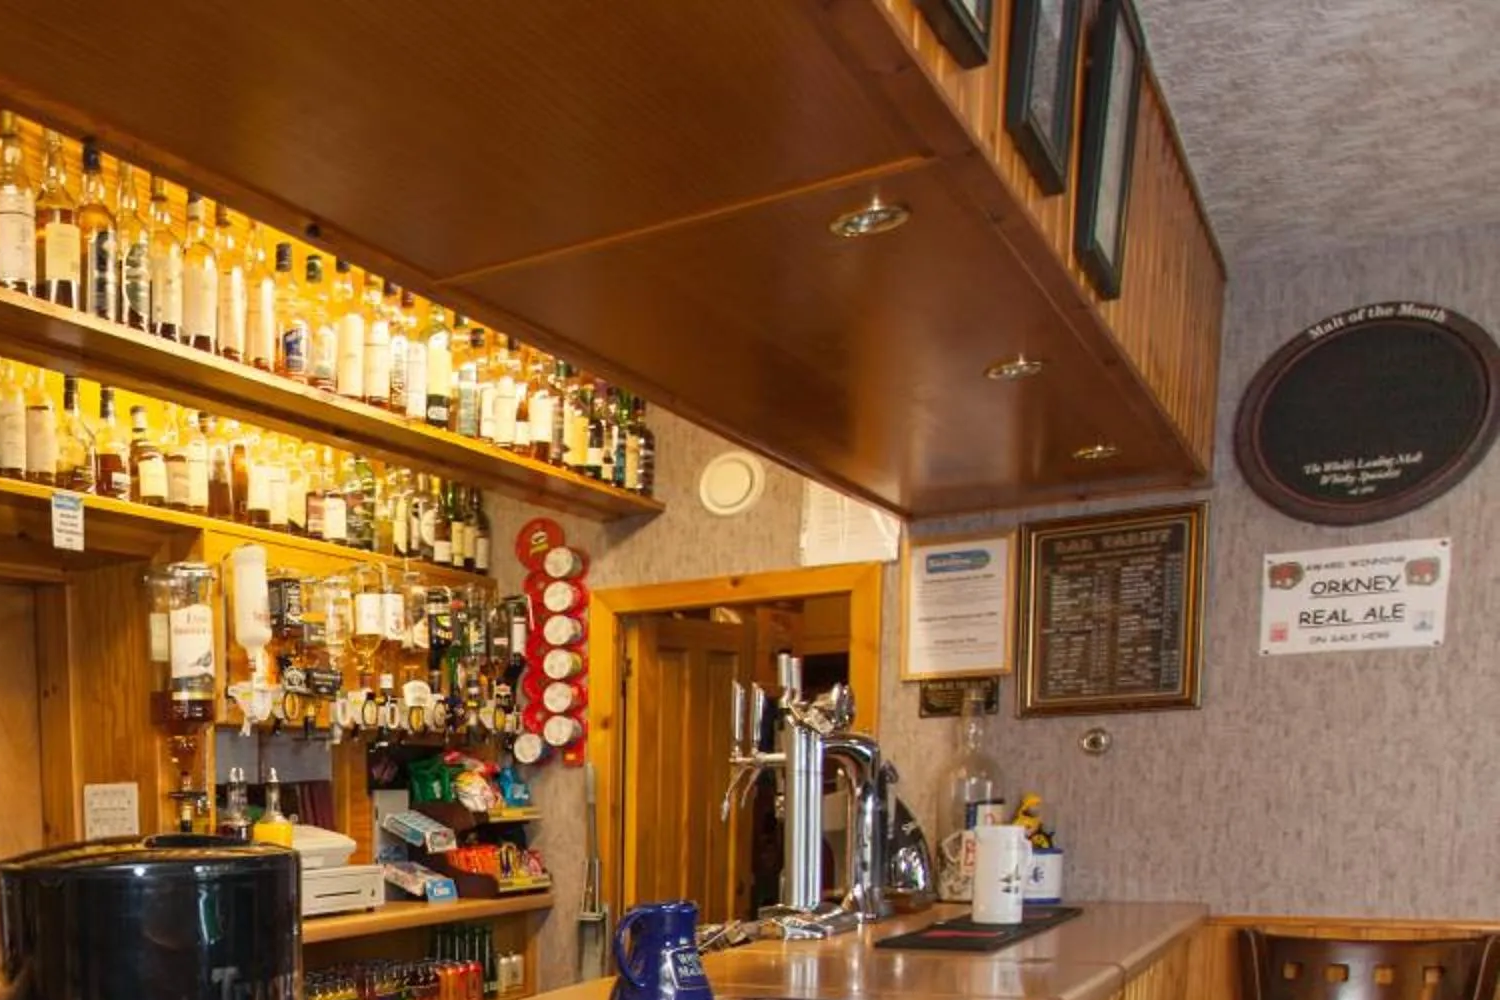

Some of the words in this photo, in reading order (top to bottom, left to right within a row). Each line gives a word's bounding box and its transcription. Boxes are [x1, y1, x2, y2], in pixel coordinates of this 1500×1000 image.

[1308, 317, 1345, 340] Malt
[1348, 308, 1367, 323] of
[1368, 304, 1394, 319] the
[1397, 302, 1447, 323] Month
[1310, 574, 1402, 596] ORKNEY
[1299, 608, 1352, 626] REAL
[1364, 603, 1406, 621] ALE
